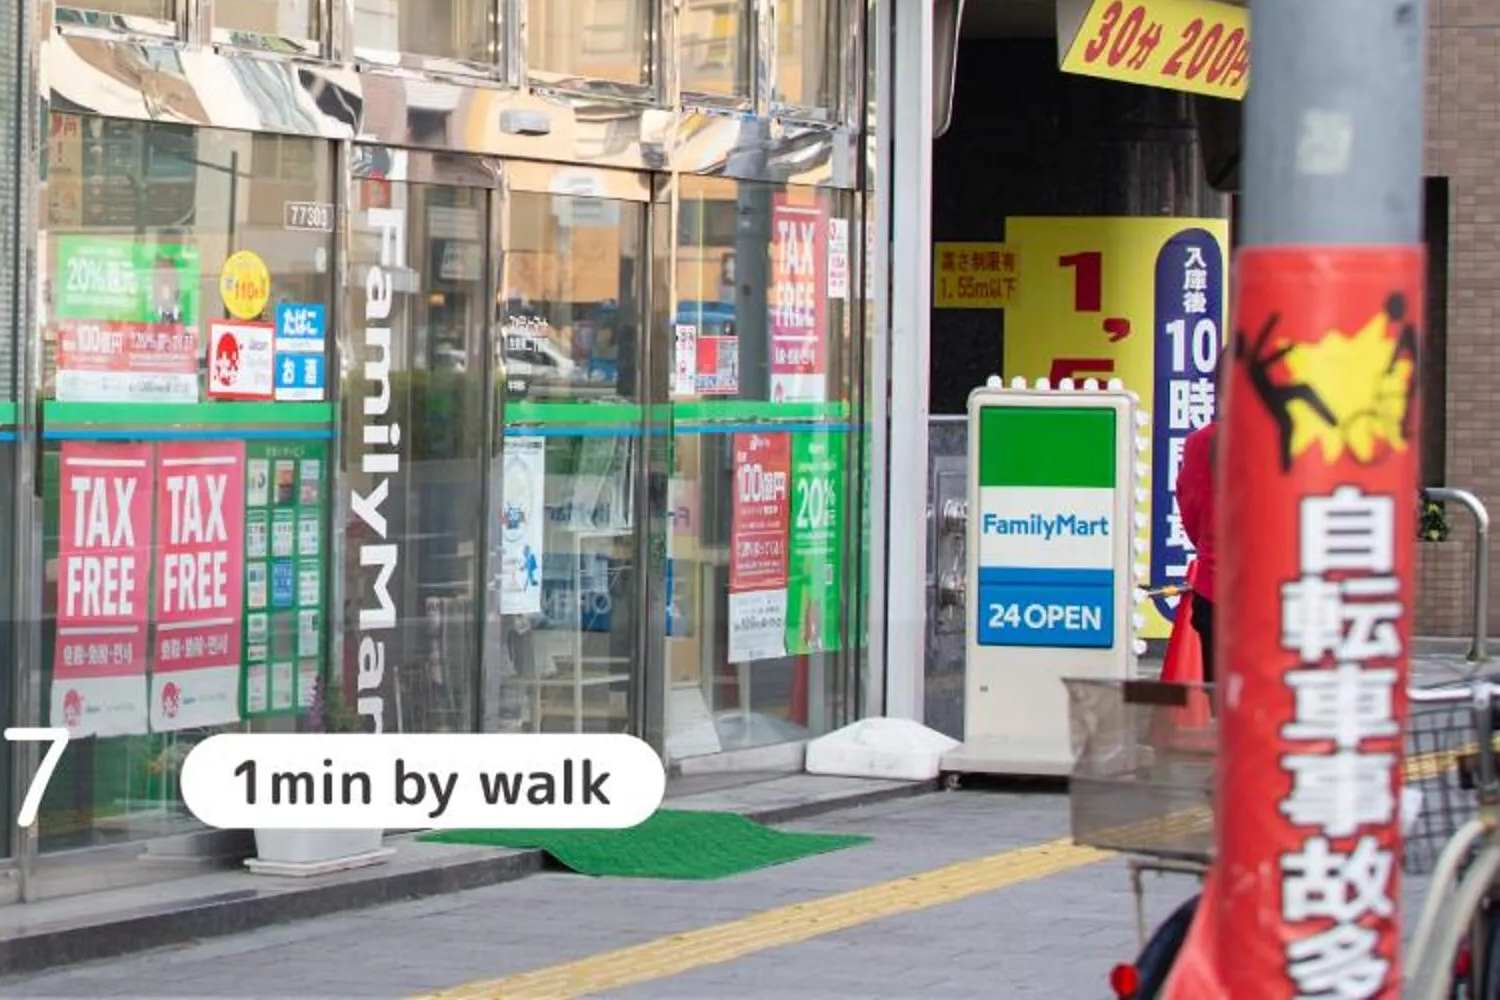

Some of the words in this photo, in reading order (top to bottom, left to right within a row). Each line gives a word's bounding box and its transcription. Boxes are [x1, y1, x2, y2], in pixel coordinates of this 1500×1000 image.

[1084, 0, 1163, 70] 30分
[777, 219, 816, 276] TAX
[774, 282, 816, 328] FREE
[351, 207, 400, 735] FamilyMar
[71, 476, 137, 547] TAX
[166, 474, 228, 544] TAX
[982, 513, 1110, 541] FamilyMart
[66, 556, 135, 617] FREE
[163, 552, 228, 612] FREE
[987, 603, 1021, 628] 24
[1023, 604, 1102, 631] OPEN
